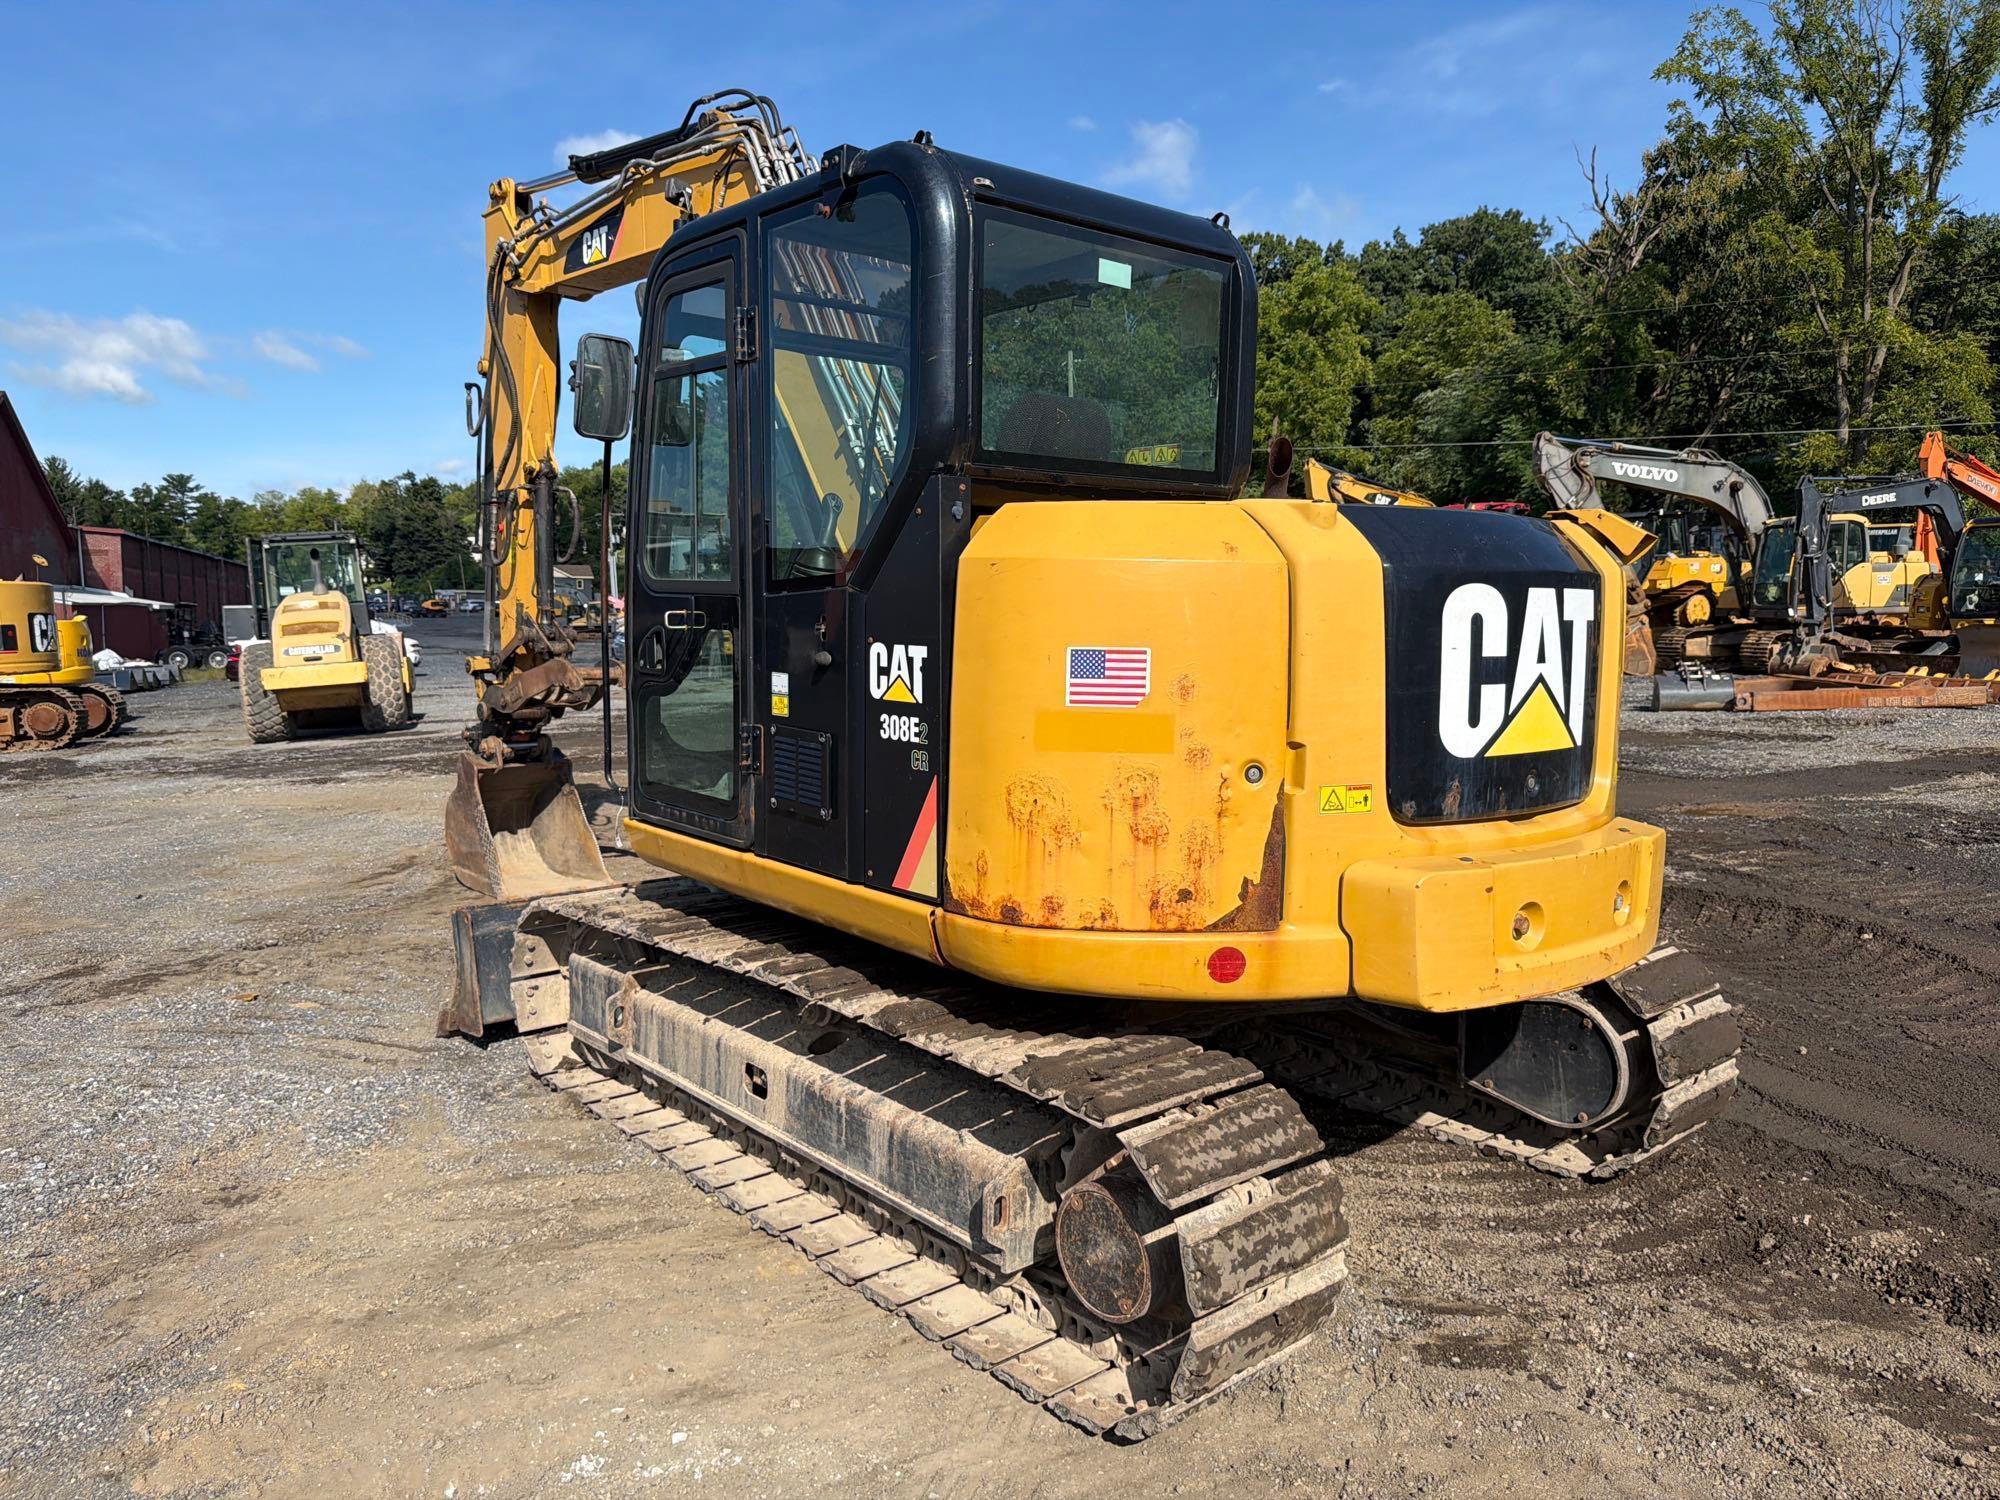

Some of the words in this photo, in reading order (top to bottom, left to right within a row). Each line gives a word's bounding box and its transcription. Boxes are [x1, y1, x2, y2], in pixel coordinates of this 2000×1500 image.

[583, 225, 608, 264] CAT
[1612, 462, 1679, 482] VOLVO
[1375, 494, 1391, 505] CAT
[1862, 492, 1896, 507] DEERE
[33, 614, 57, 652] CA
[288, 645, 335, 656] CATERPILLAR
[870, 641, 927, 704] CAT
[1439, 583, 1594, 758] CAT
[880, 714, 928, 744] 308E2
[911, 749, 928, 771] CR
